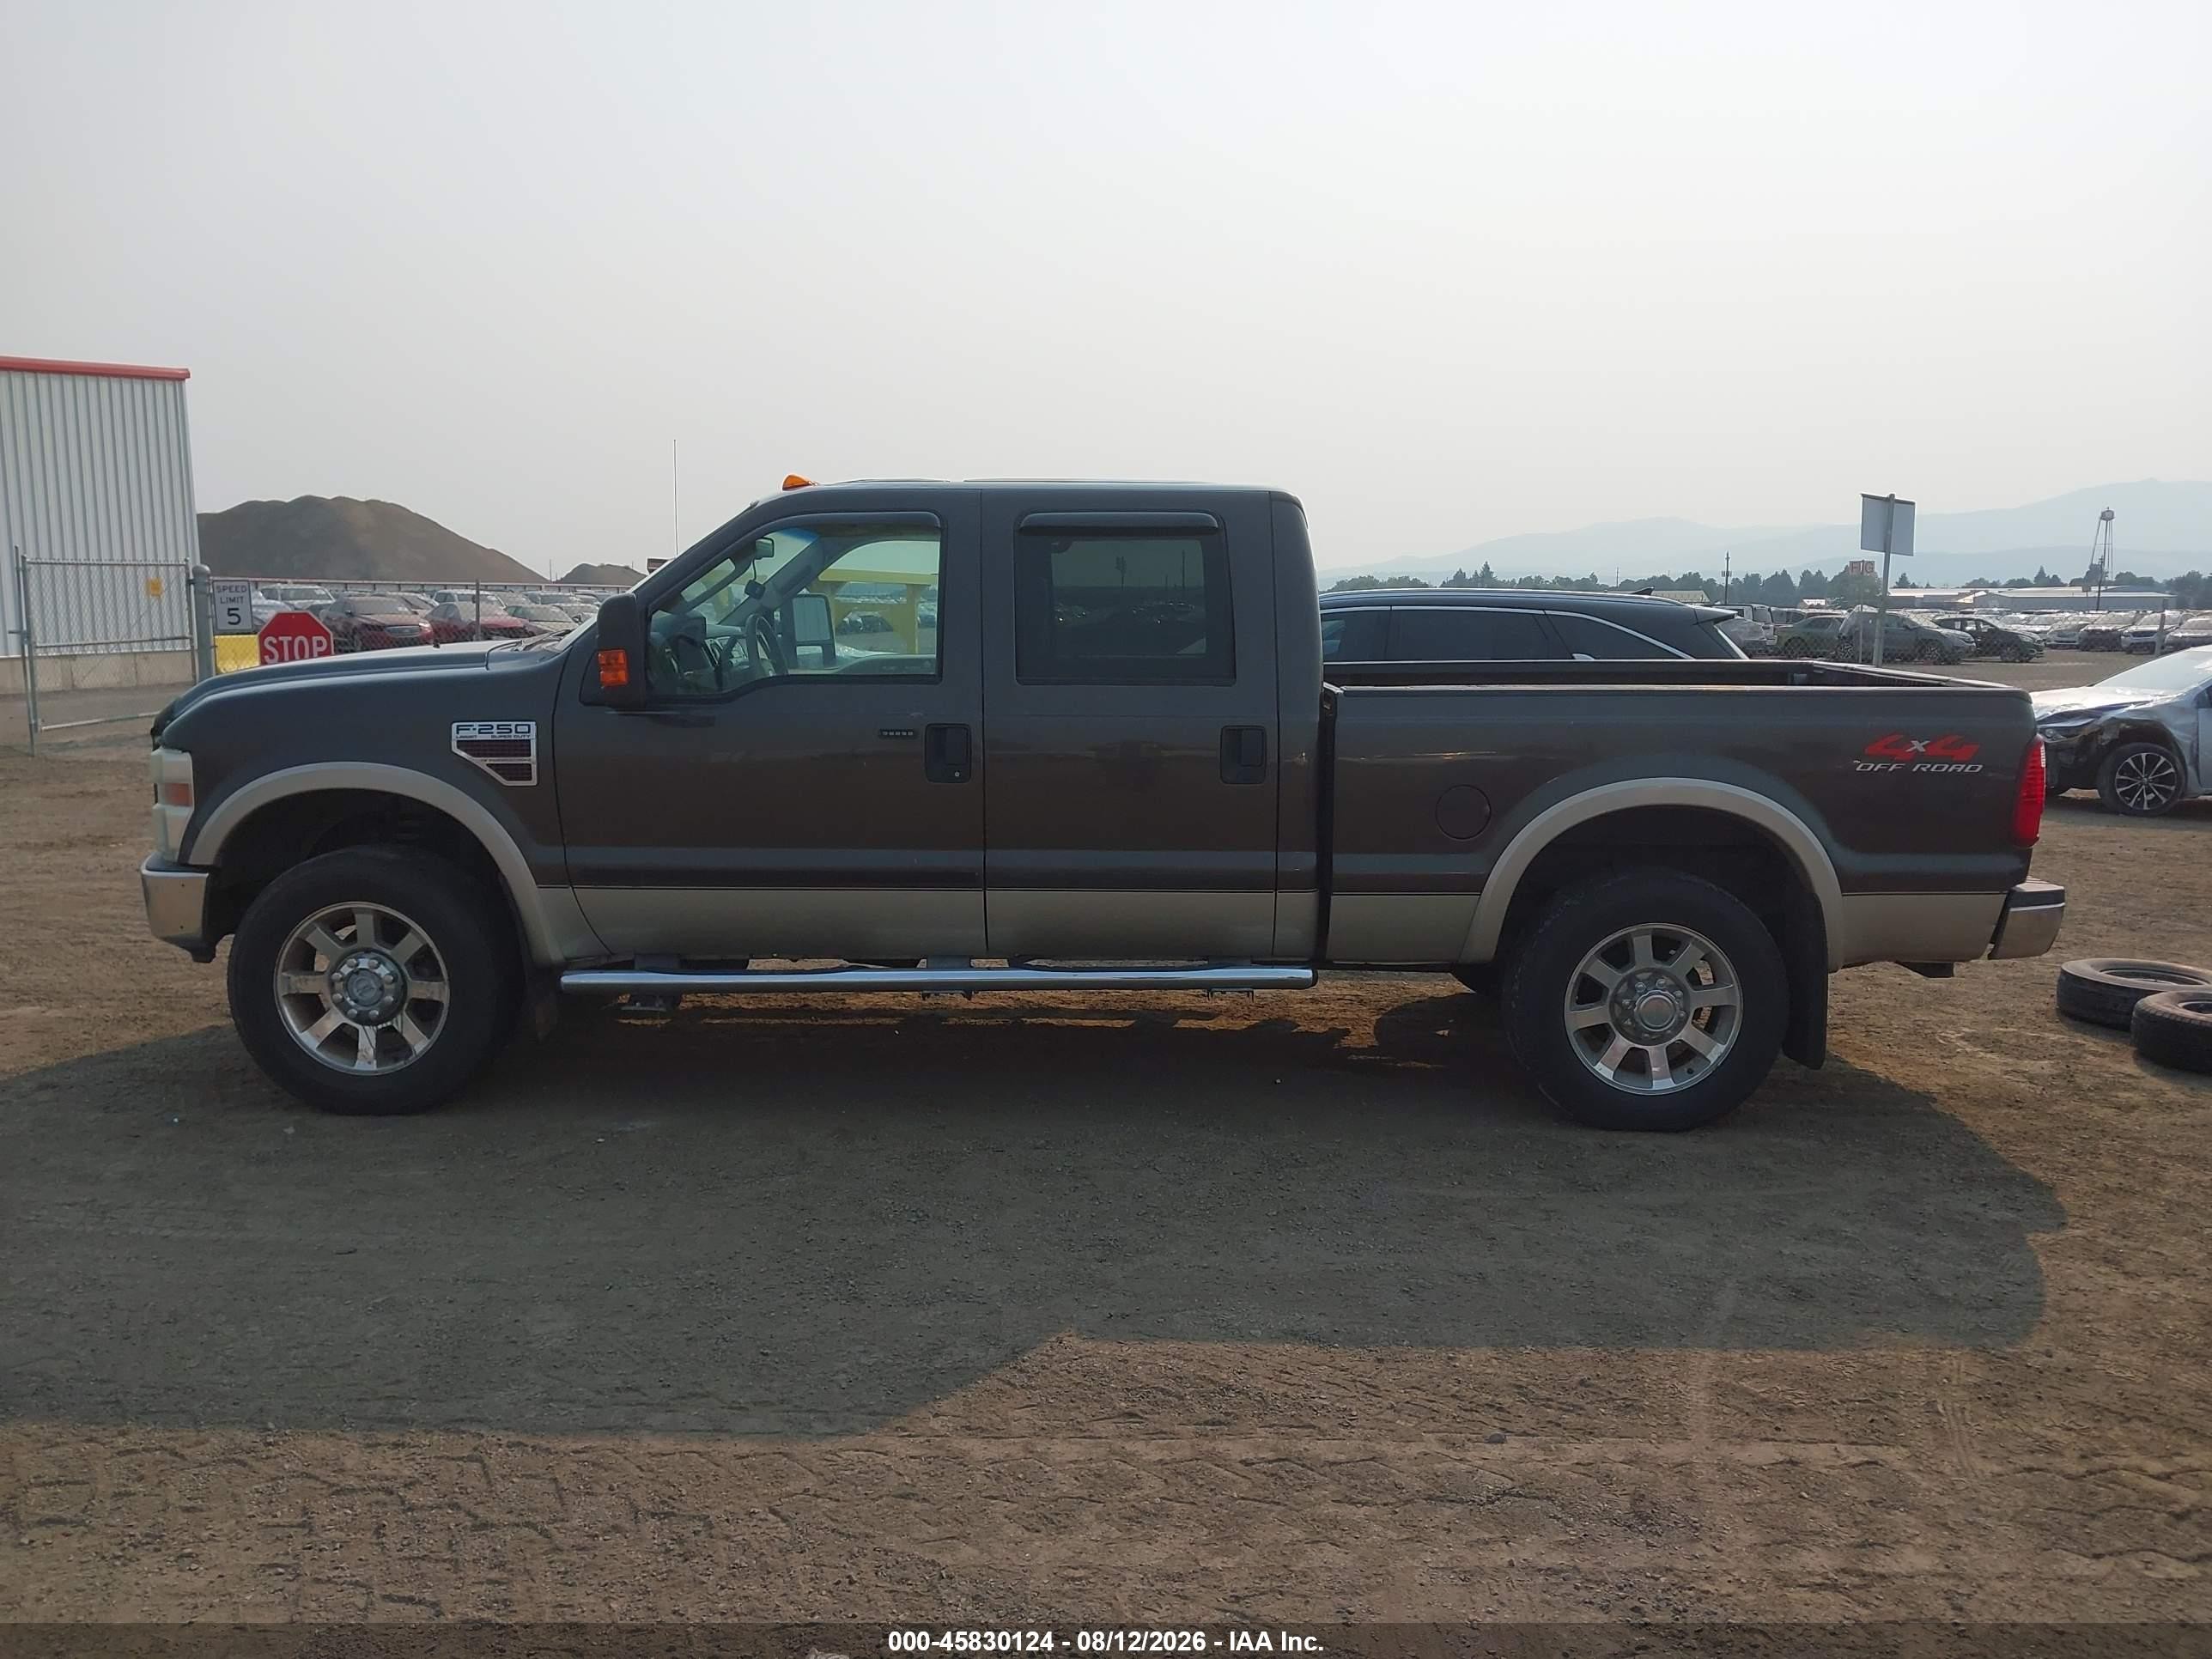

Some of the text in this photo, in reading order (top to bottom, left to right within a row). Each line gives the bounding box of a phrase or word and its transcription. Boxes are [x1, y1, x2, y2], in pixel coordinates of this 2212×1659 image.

[216, 585, 247, 593] SPEED
[220, 596, 244, 605] LIMIT
[227, 607, 241, 626] 5
[264, 635, 328, 665] STOP
[456, 724, 531, 734] F-250
[1856, 763, 1984, 773] OFF ROAD
